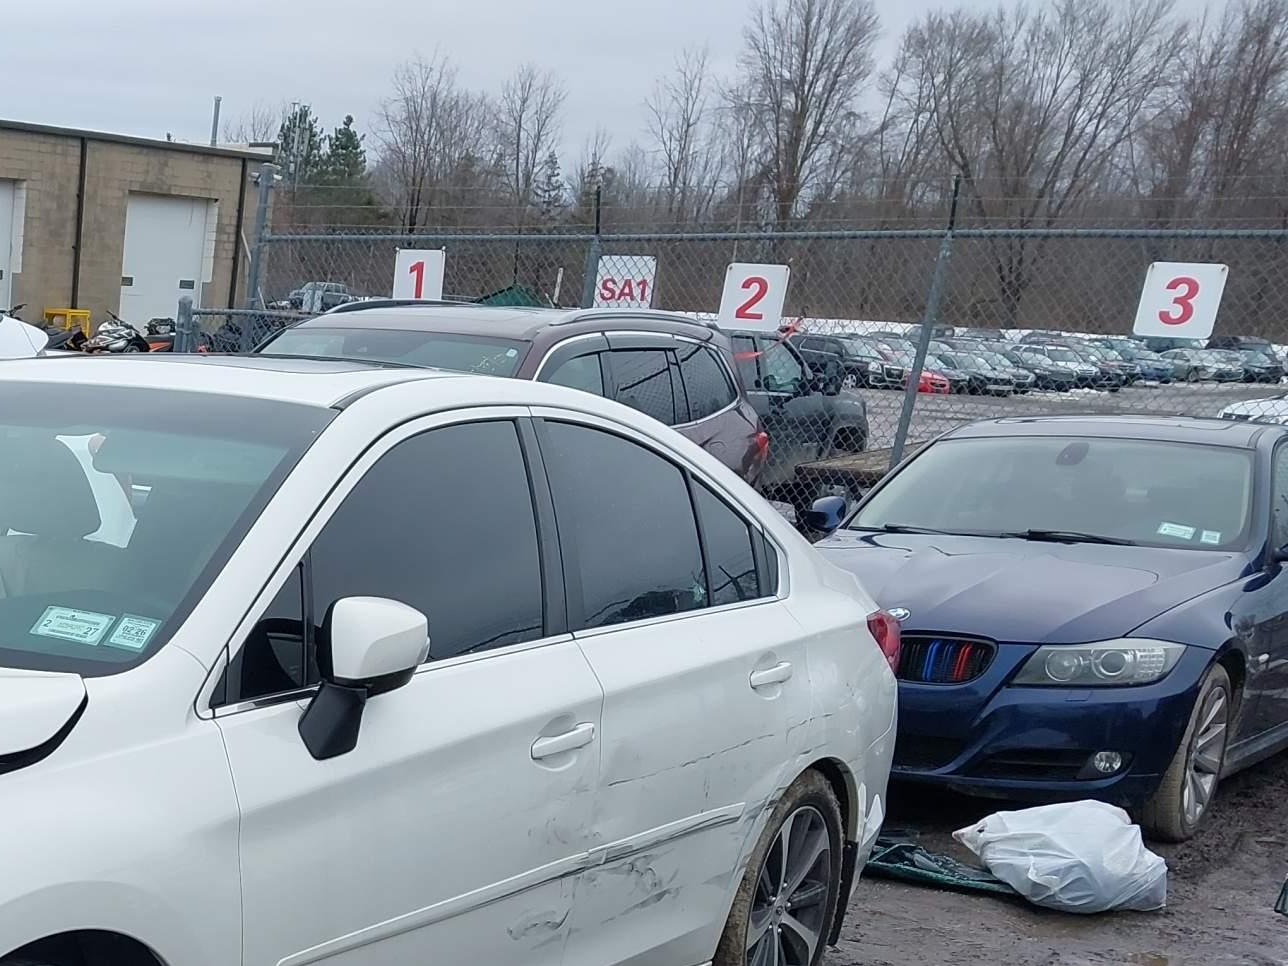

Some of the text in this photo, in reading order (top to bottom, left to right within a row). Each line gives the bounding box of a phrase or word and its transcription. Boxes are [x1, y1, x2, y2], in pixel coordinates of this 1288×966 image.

[409, 261, 424, 299] 1
[600, 278, 649, 302] SA1
[735, 276, 769, 320] 2
[1159, 277, 1200, 325] 3
[83, 626, 100, 637] 27
